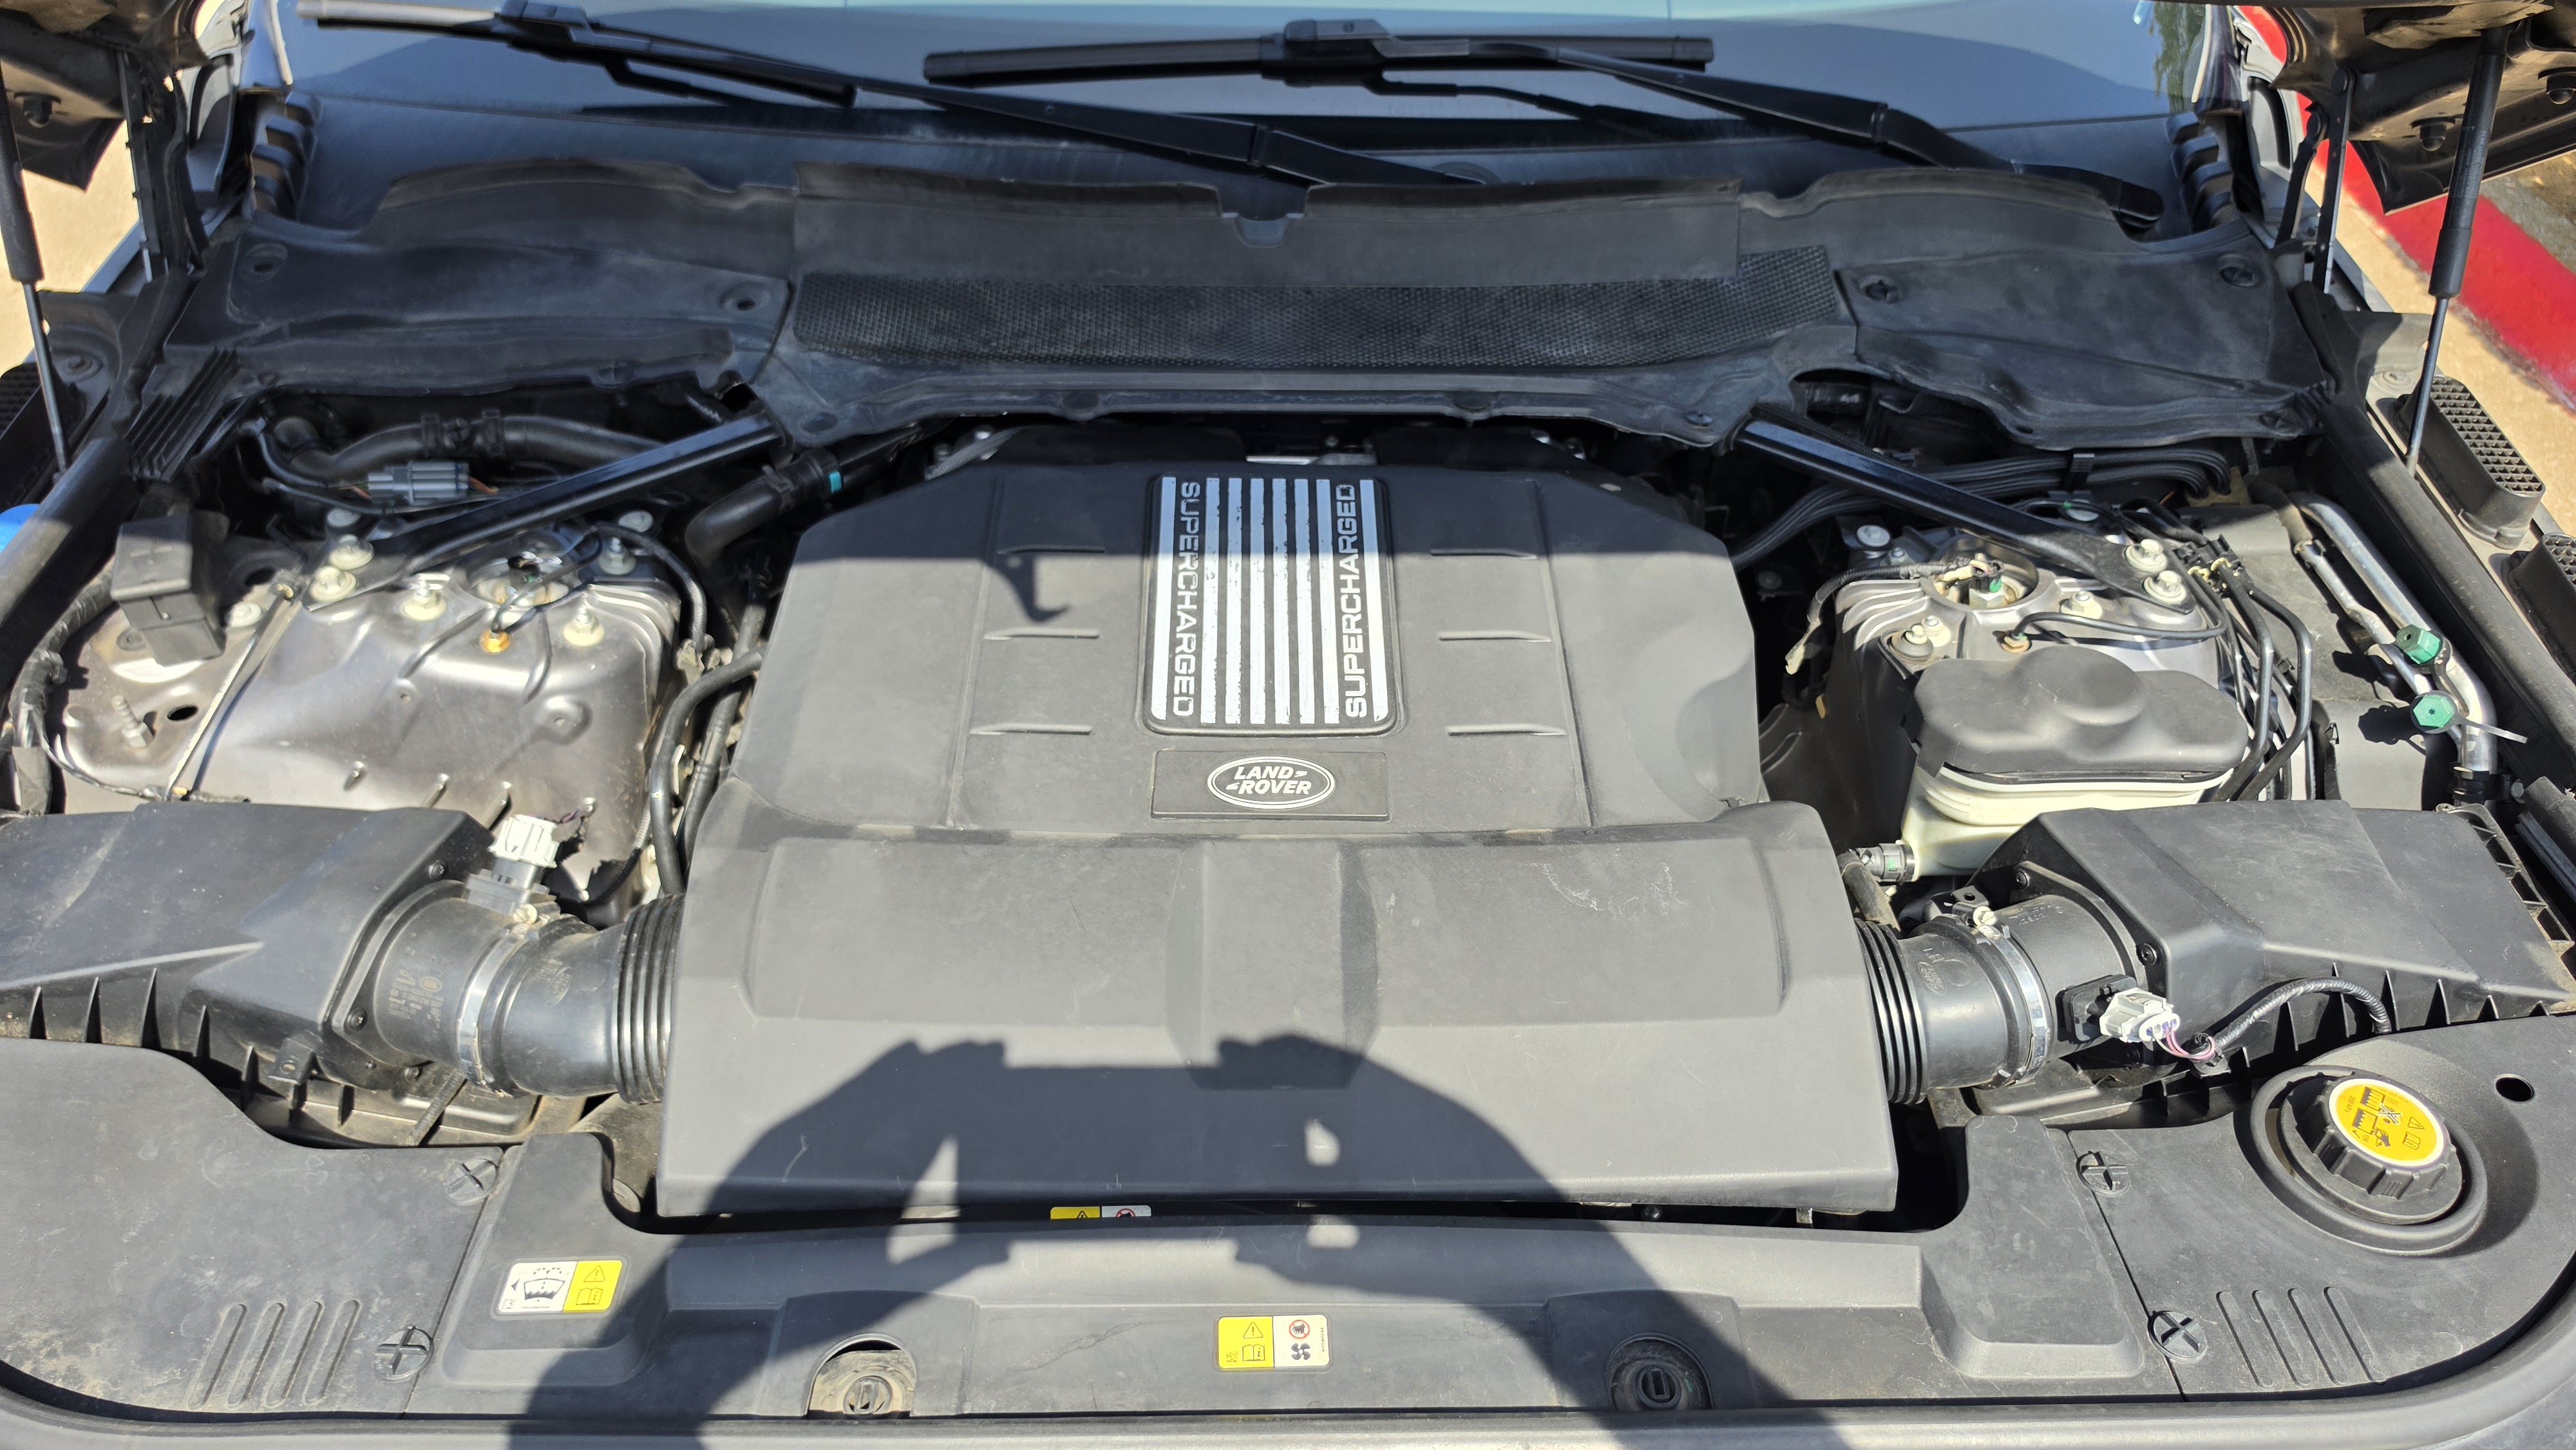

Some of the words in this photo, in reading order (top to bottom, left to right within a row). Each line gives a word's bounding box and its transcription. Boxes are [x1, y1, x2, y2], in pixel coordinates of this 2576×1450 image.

[1173, 482, 1200, 717] SUPERCHARGED
[1335, 484, 1367, 719] SUPERCHARGED
[1234, 766, 1294, 780] LAND
[1238, 780, 1311, 795] ROVER
